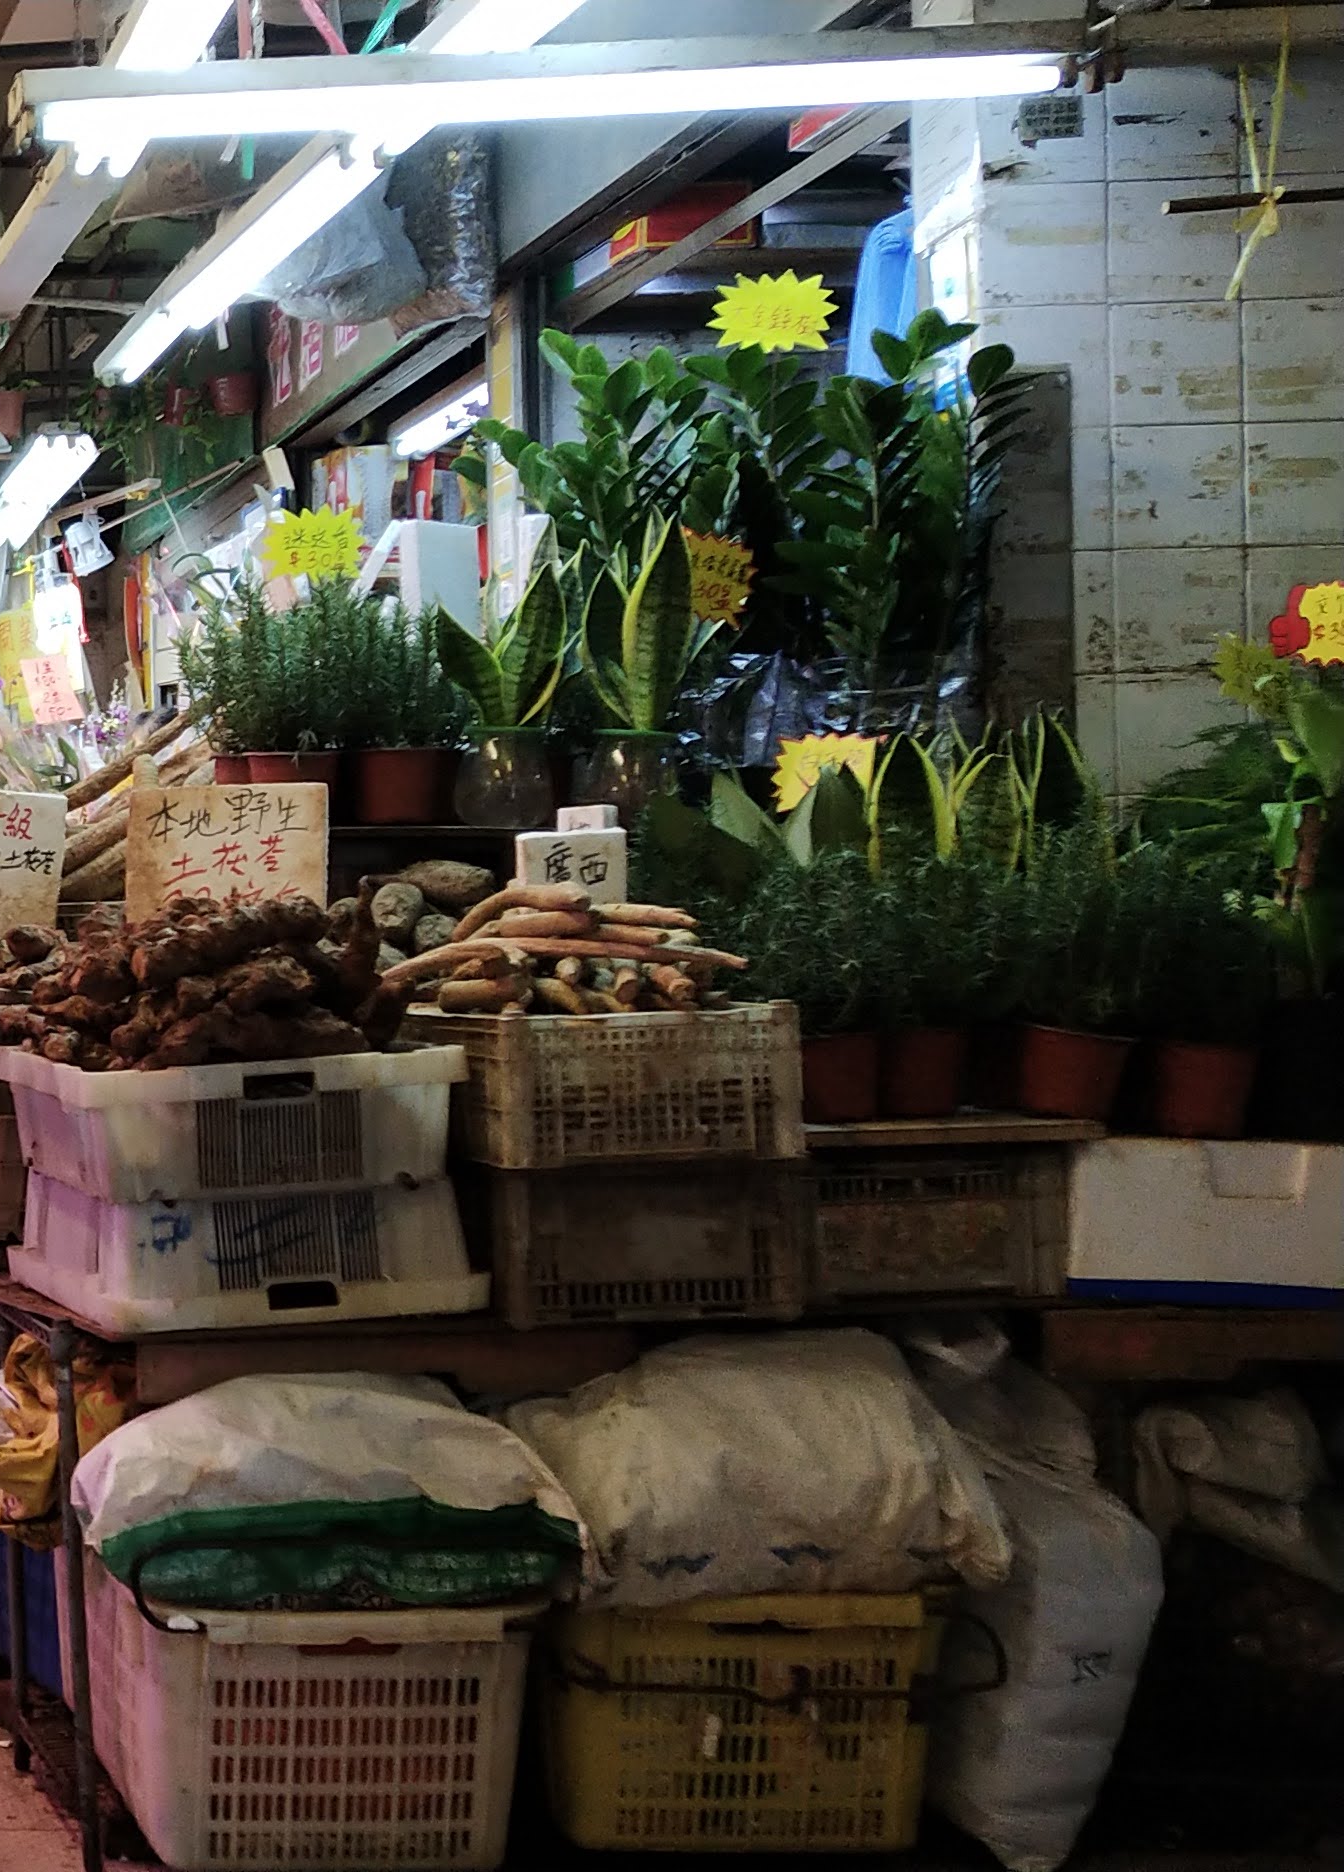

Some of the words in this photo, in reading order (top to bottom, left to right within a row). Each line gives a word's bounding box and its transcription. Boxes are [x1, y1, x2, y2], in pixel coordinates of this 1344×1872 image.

[145, 788, 311, 843] 本地野生
[162, 834, 289, 887] 土茯苓
